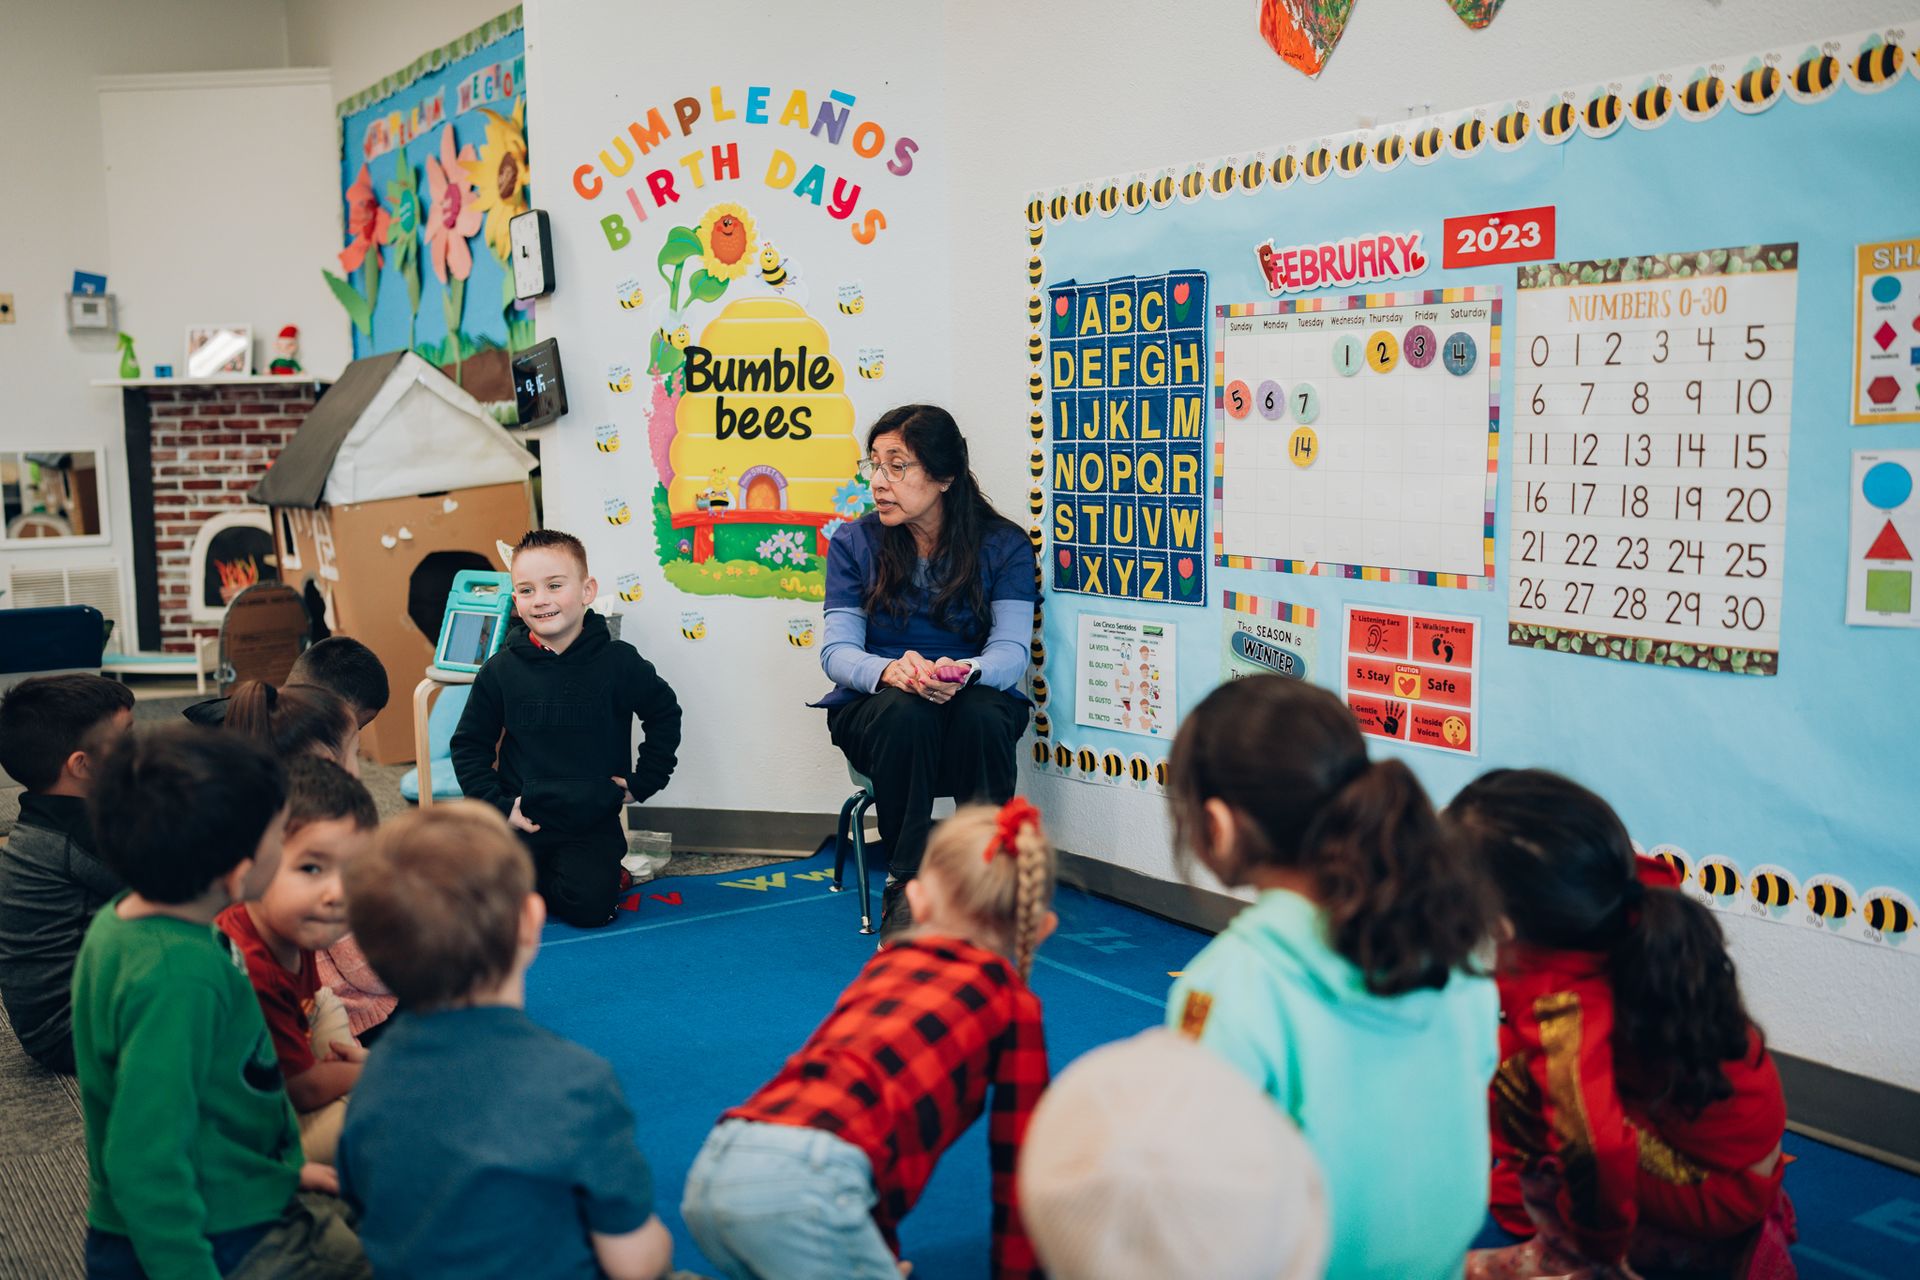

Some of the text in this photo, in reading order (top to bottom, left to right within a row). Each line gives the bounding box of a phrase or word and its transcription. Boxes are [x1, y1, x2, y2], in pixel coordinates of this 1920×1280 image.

[572, 85, 919, 200] CUMPLEAÑOS
[601, 142, 740, 251] BIRTH
[1457, 221, 1541, 255] 2023
[1271, 234, 1418, 290] FEBRUARY
[1230, 308, 1487, 333] Sunday Monday Tuesday Wednesday Thursday Friday Saturday
[1568, 286, 1727, 323] NUMBERS 0-30
[1377, 342, 1389, 364] 2
[1414, 336, 1426, 358] 3
[1453, 344, 1465, 365] 4
[1531, 325, 1765, 367] 0 1 2 3 4 5
[683, 345, 834, 393] Bumble
[1232, 390, 1308, 413] 5 6 7
[1532, 379, 1772, 415] 6 7 8 9 10
[715, 396, 812, 440] bees
[1295, 436, 1311, 458] 14
[1529, 433, 1767, 469] 11 12 13 14 15
[1527, 481, 1771, 523] 16 17 18 19 20
[1522, 531, 1767, 578] 21 22 23 24 25
[1358, 616, 1385, 626] Listening
[1519, 578, 1765, 631] 26 27 28 29 30
[1238, 621, 1301, 646] The SEASON is
[1423, 623, 1450, 634] Walking
[1450, 625, 1466, 634] Feet
[1243, 638, 1294, 674] WINTER
[1396, 665, 1420, 674] CAUTION
[1356, 668, 1390, 685] 5. Stay
[1428, 678, 1455, 693] Safe
[1356, 705, 1378, 715] Gentle
[1422, 717, 1442, 727] Inside
[1417, 728, 1440, 738] Voices
